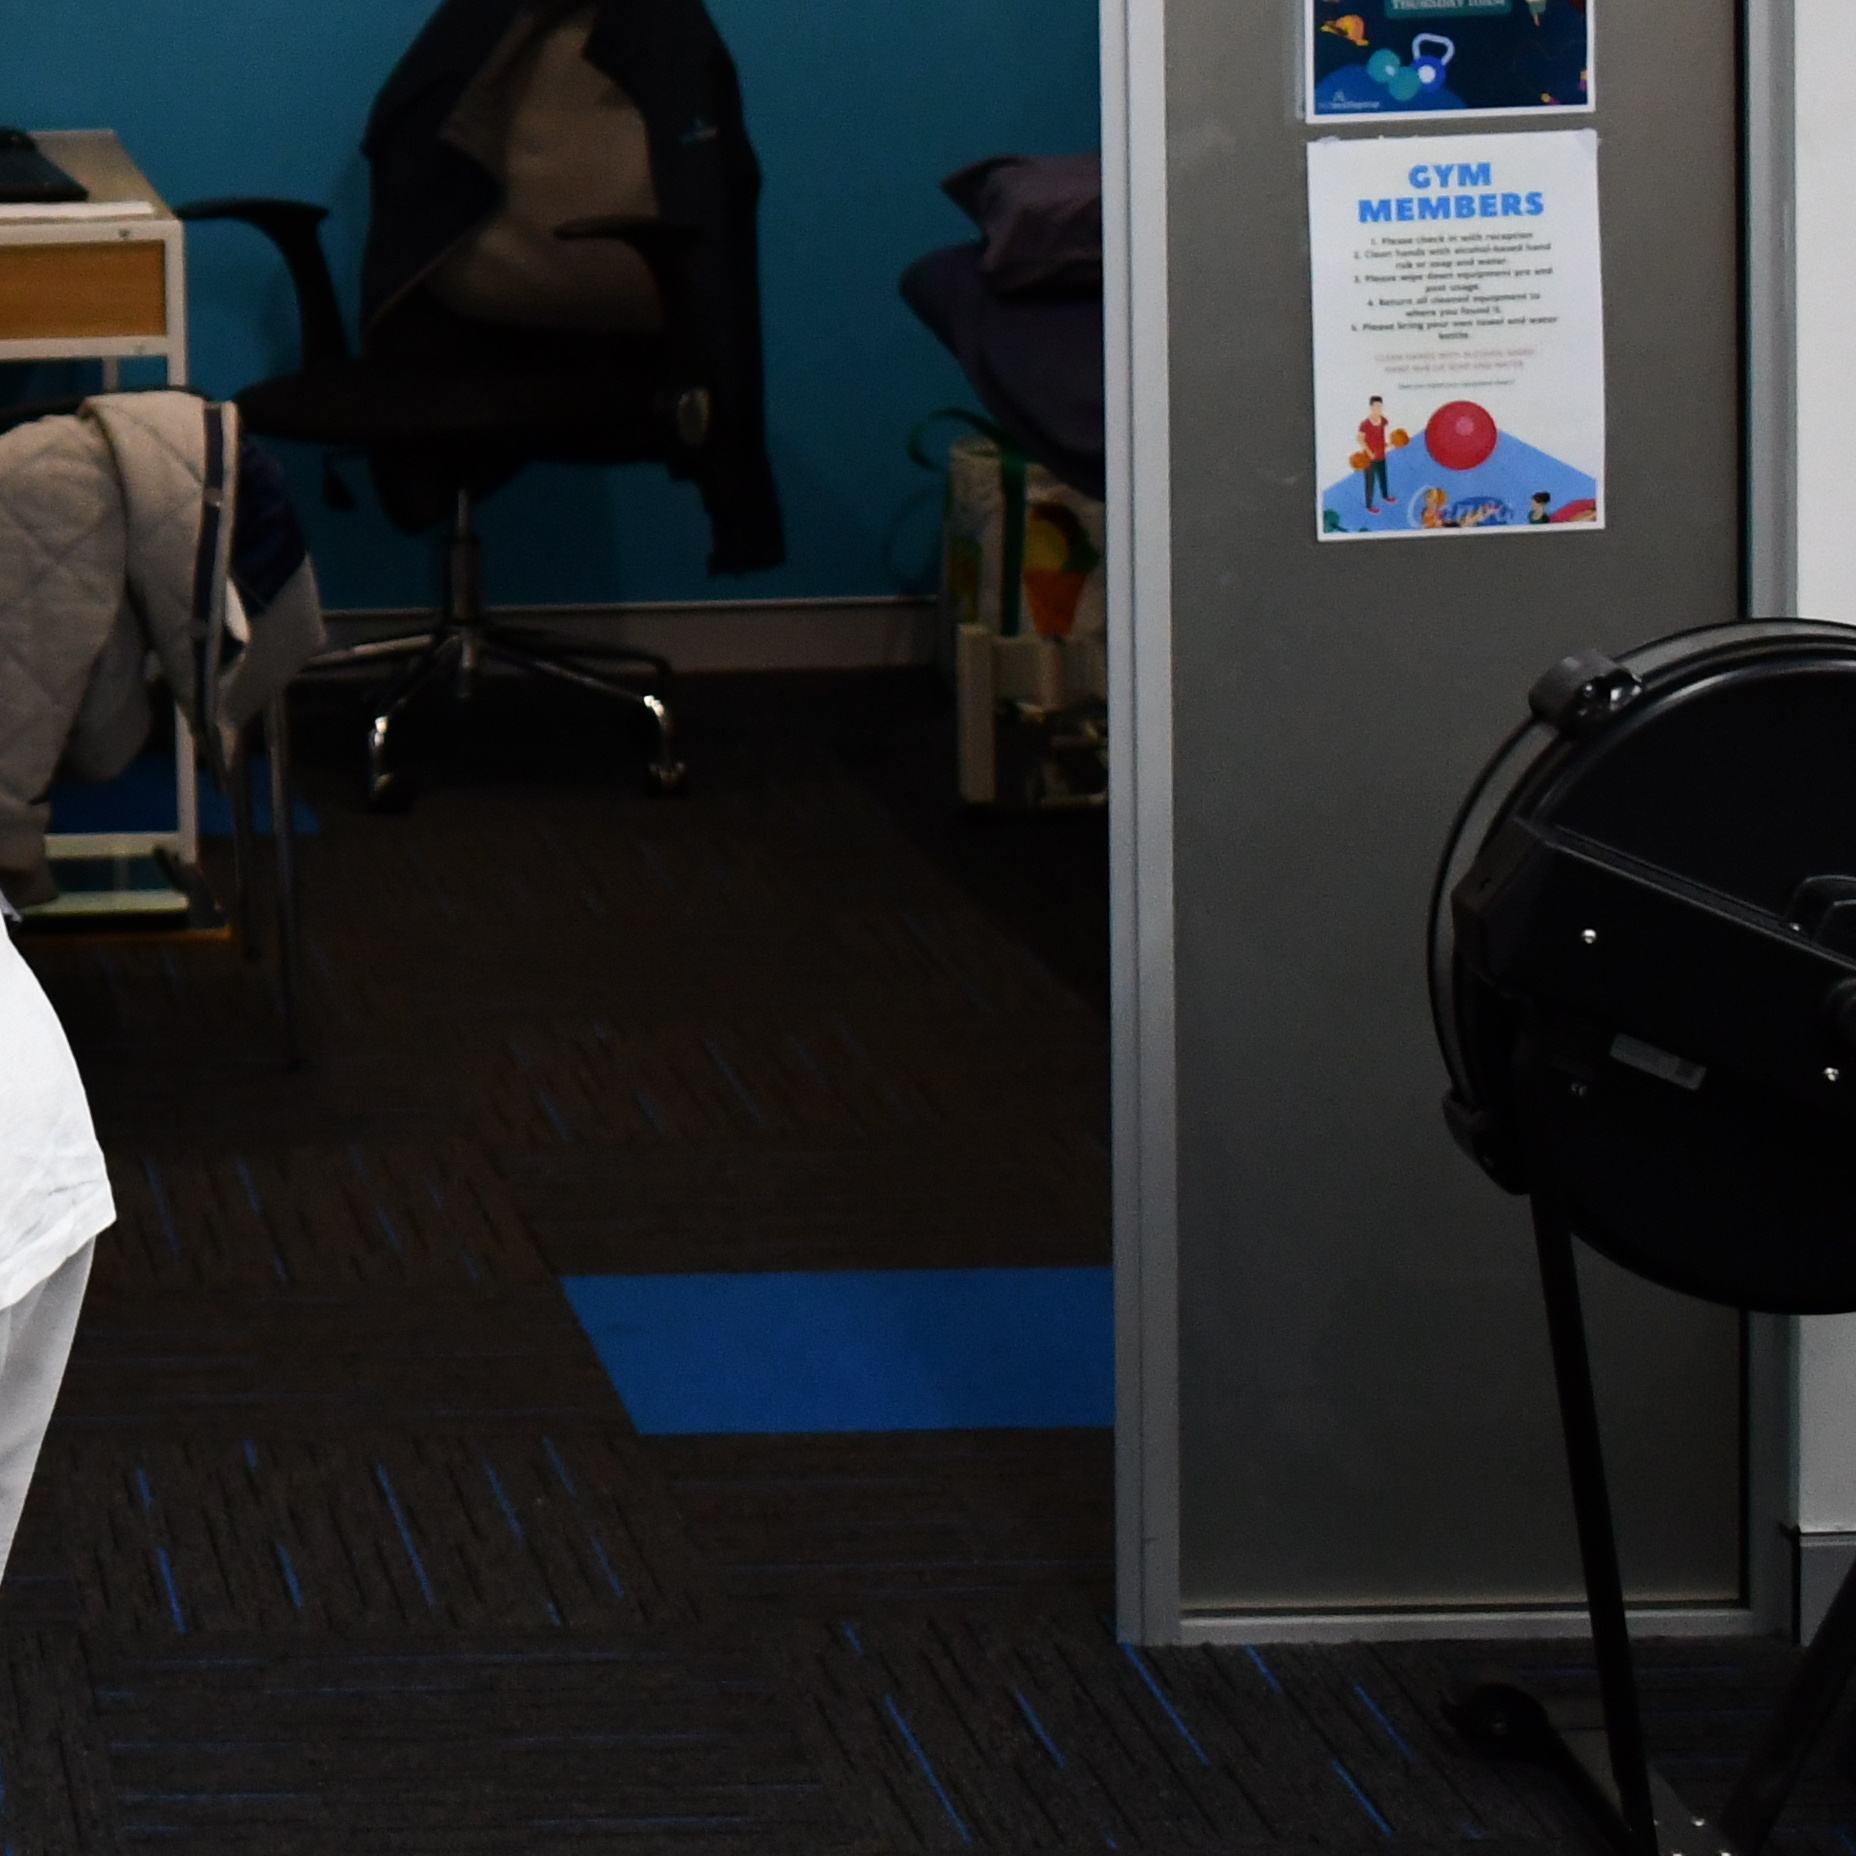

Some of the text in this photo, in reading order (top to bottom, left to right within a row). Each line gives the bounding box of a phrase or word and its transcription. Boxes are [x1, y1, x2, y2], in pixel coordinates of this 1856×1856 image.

[1408, 162, 1492, 189] GYM
[1357, 191, 1545, 223] MEMBERS
[1416, 235, 1444, 243] check
[1486, 232, 1533, 241] reception
[1365, 250, 1392, 258] Clean
[1395, 248, 1425, 256] hands
[1429, 247, 1451, 255] with
[1526, 243, 1551, 251] hand
[1430, 261, 1452, 269] soap
[1365, 274, 1396, 282] Please
[1457, 270, 1510, 280] equipment
[1534, 267, 1553, 275] and
[1379, 298, 1412, 306] Return
[1473, 293, 1527, 303] equipment
[1363, 323, 1394, 331] Please
[1397, 321, 1423, 330] bring
[1507, 316, 1526, 324] and
[1530, 316, 1558, 324] water
